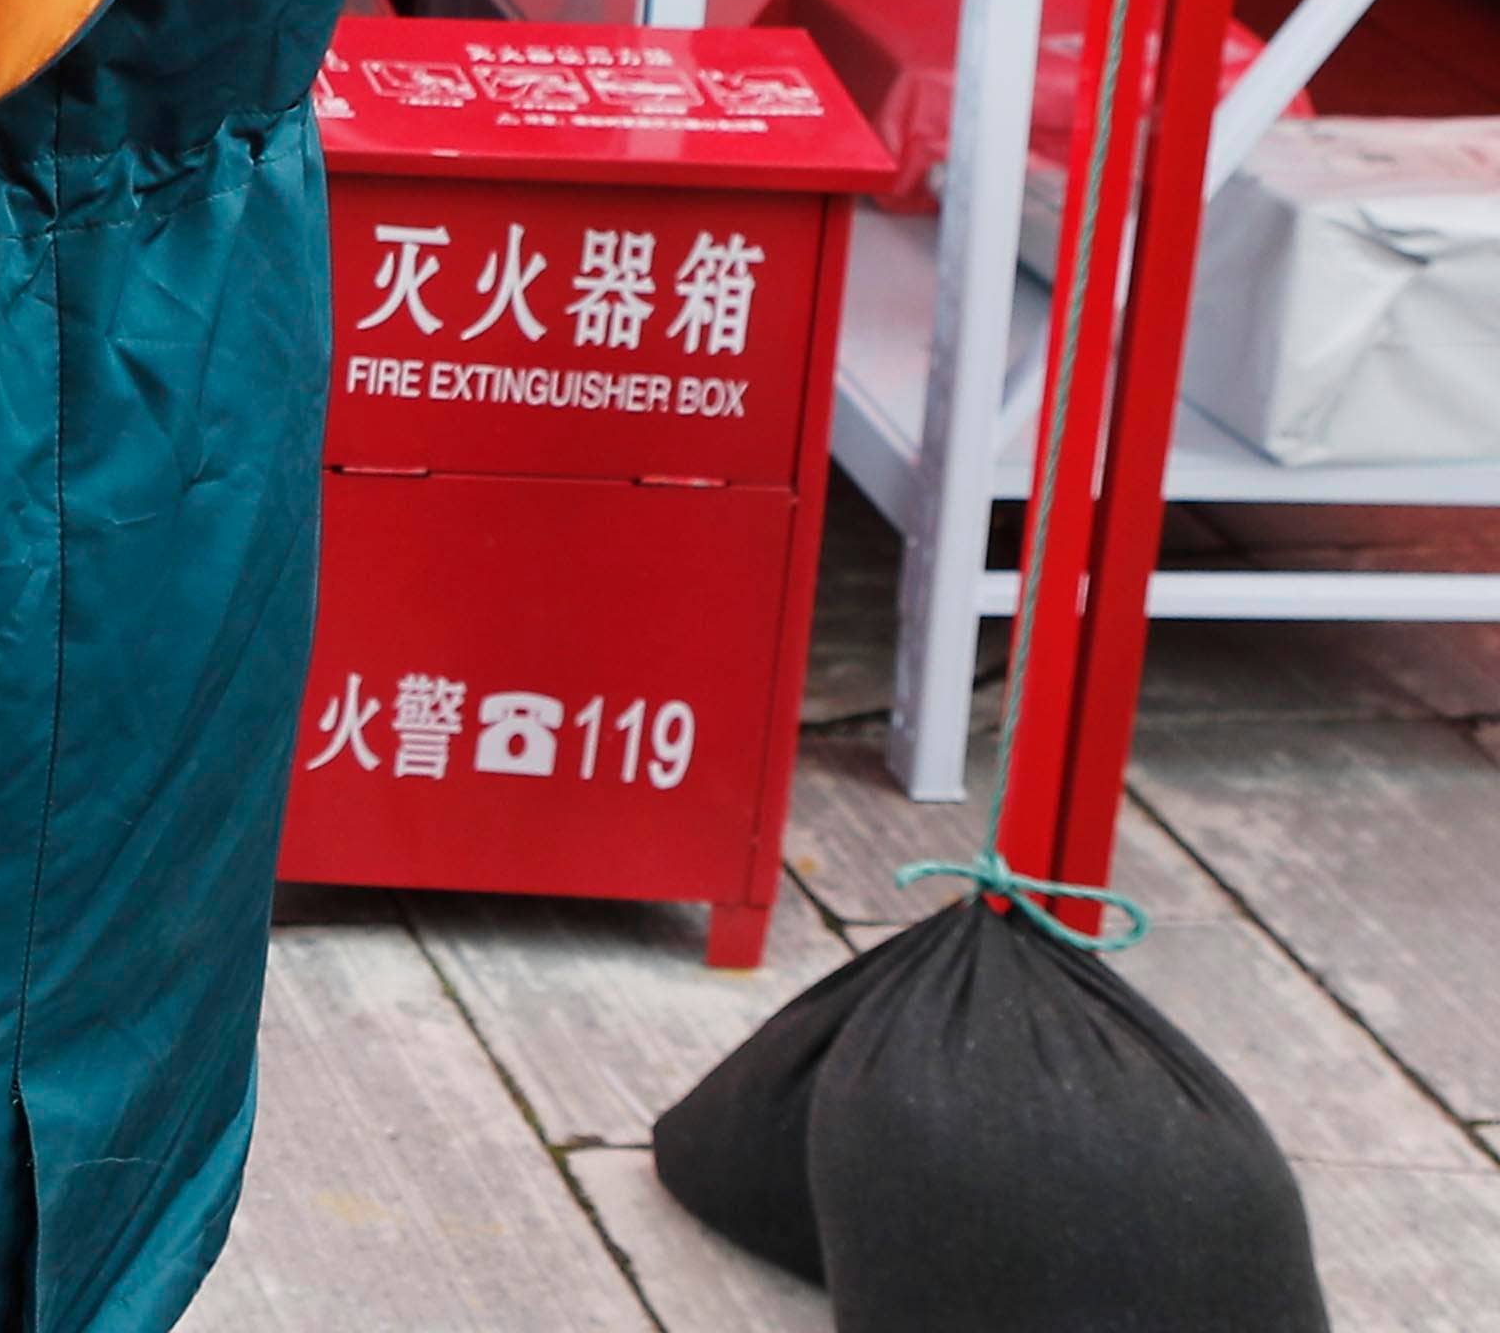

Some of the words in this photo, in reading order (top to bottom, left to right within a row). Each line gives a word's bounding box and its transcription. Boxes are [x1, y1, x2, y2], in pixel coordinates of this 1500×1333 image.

[356, 222, 765, 355] 灭火器箱
[346, 356, 423, 397] FIRE
[428, 362, 672, 414] EXTINGUISHER
[676, 376, 748, 418] BOX
[305, 672, 467, 780] 火警
[573, 695, 695, 790] 119
